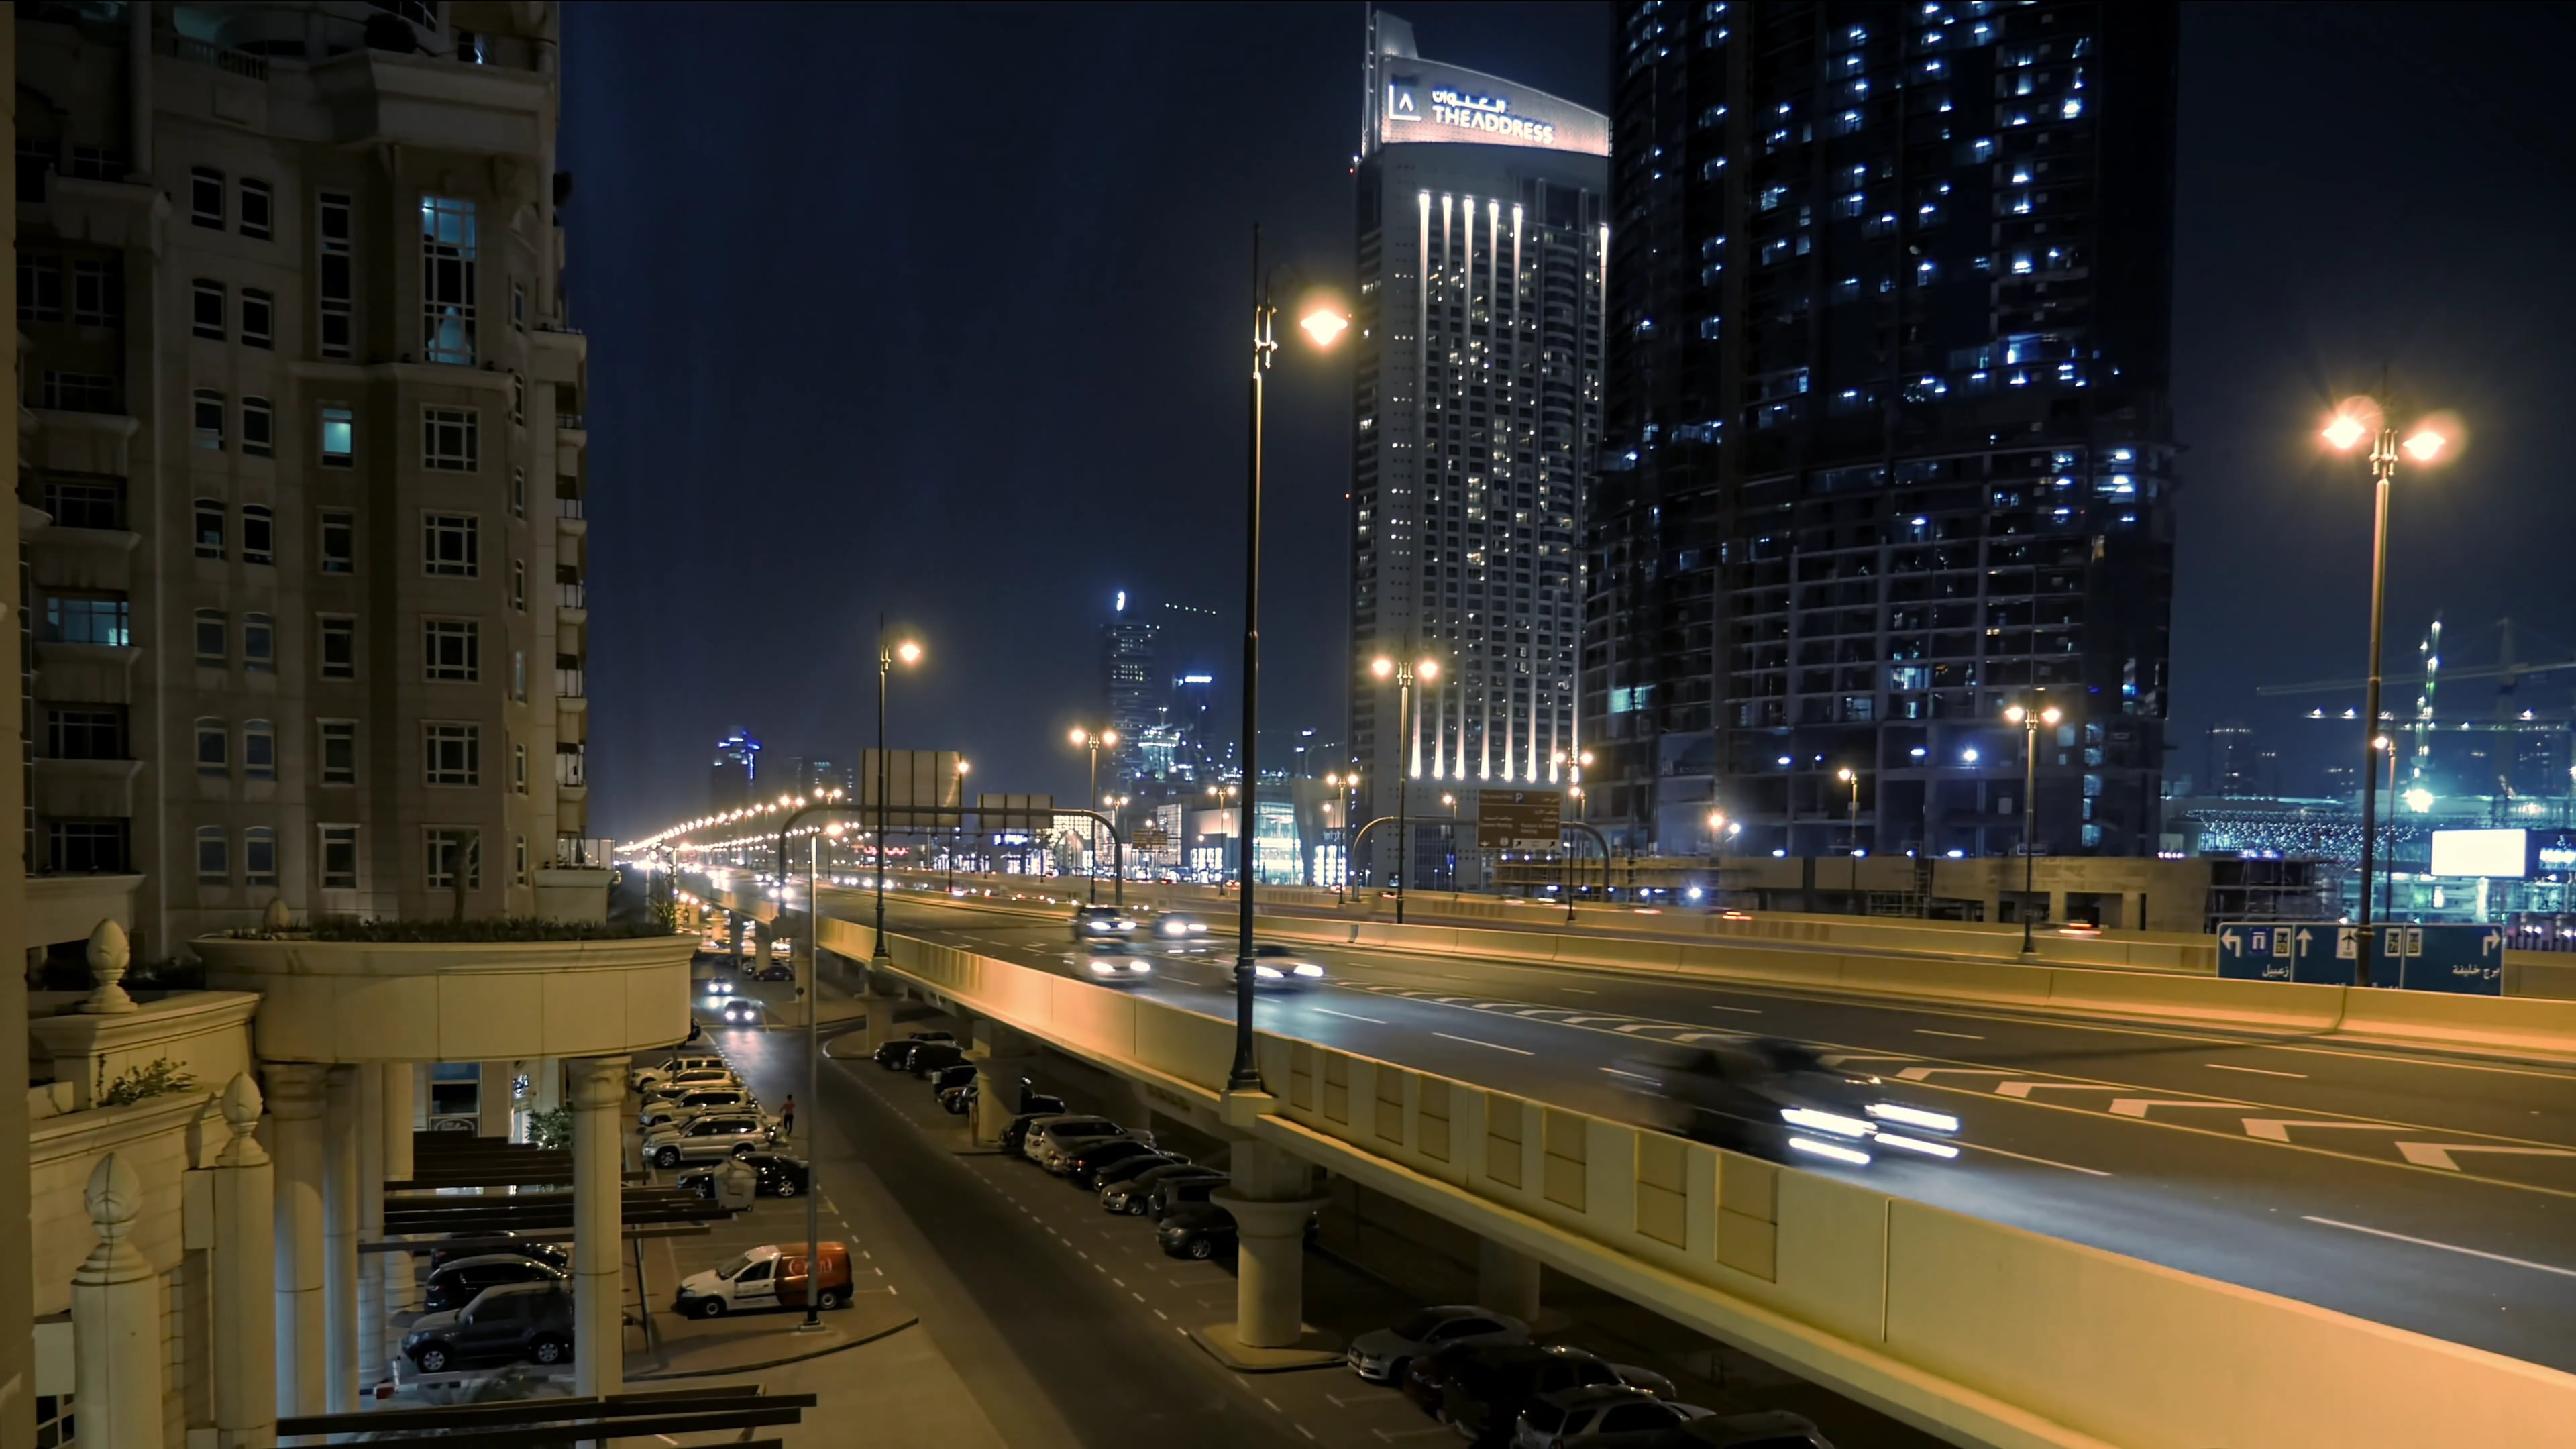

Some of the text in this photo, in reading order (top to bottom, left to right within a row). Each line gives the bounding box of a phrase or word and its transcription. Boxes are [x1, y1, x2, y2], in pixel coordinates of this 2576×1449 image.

[1515, 792, 1523, 803] P
[2261, 964, 2289, 977] زعبيل
[2452, 963, 2481, 977] خليفة
